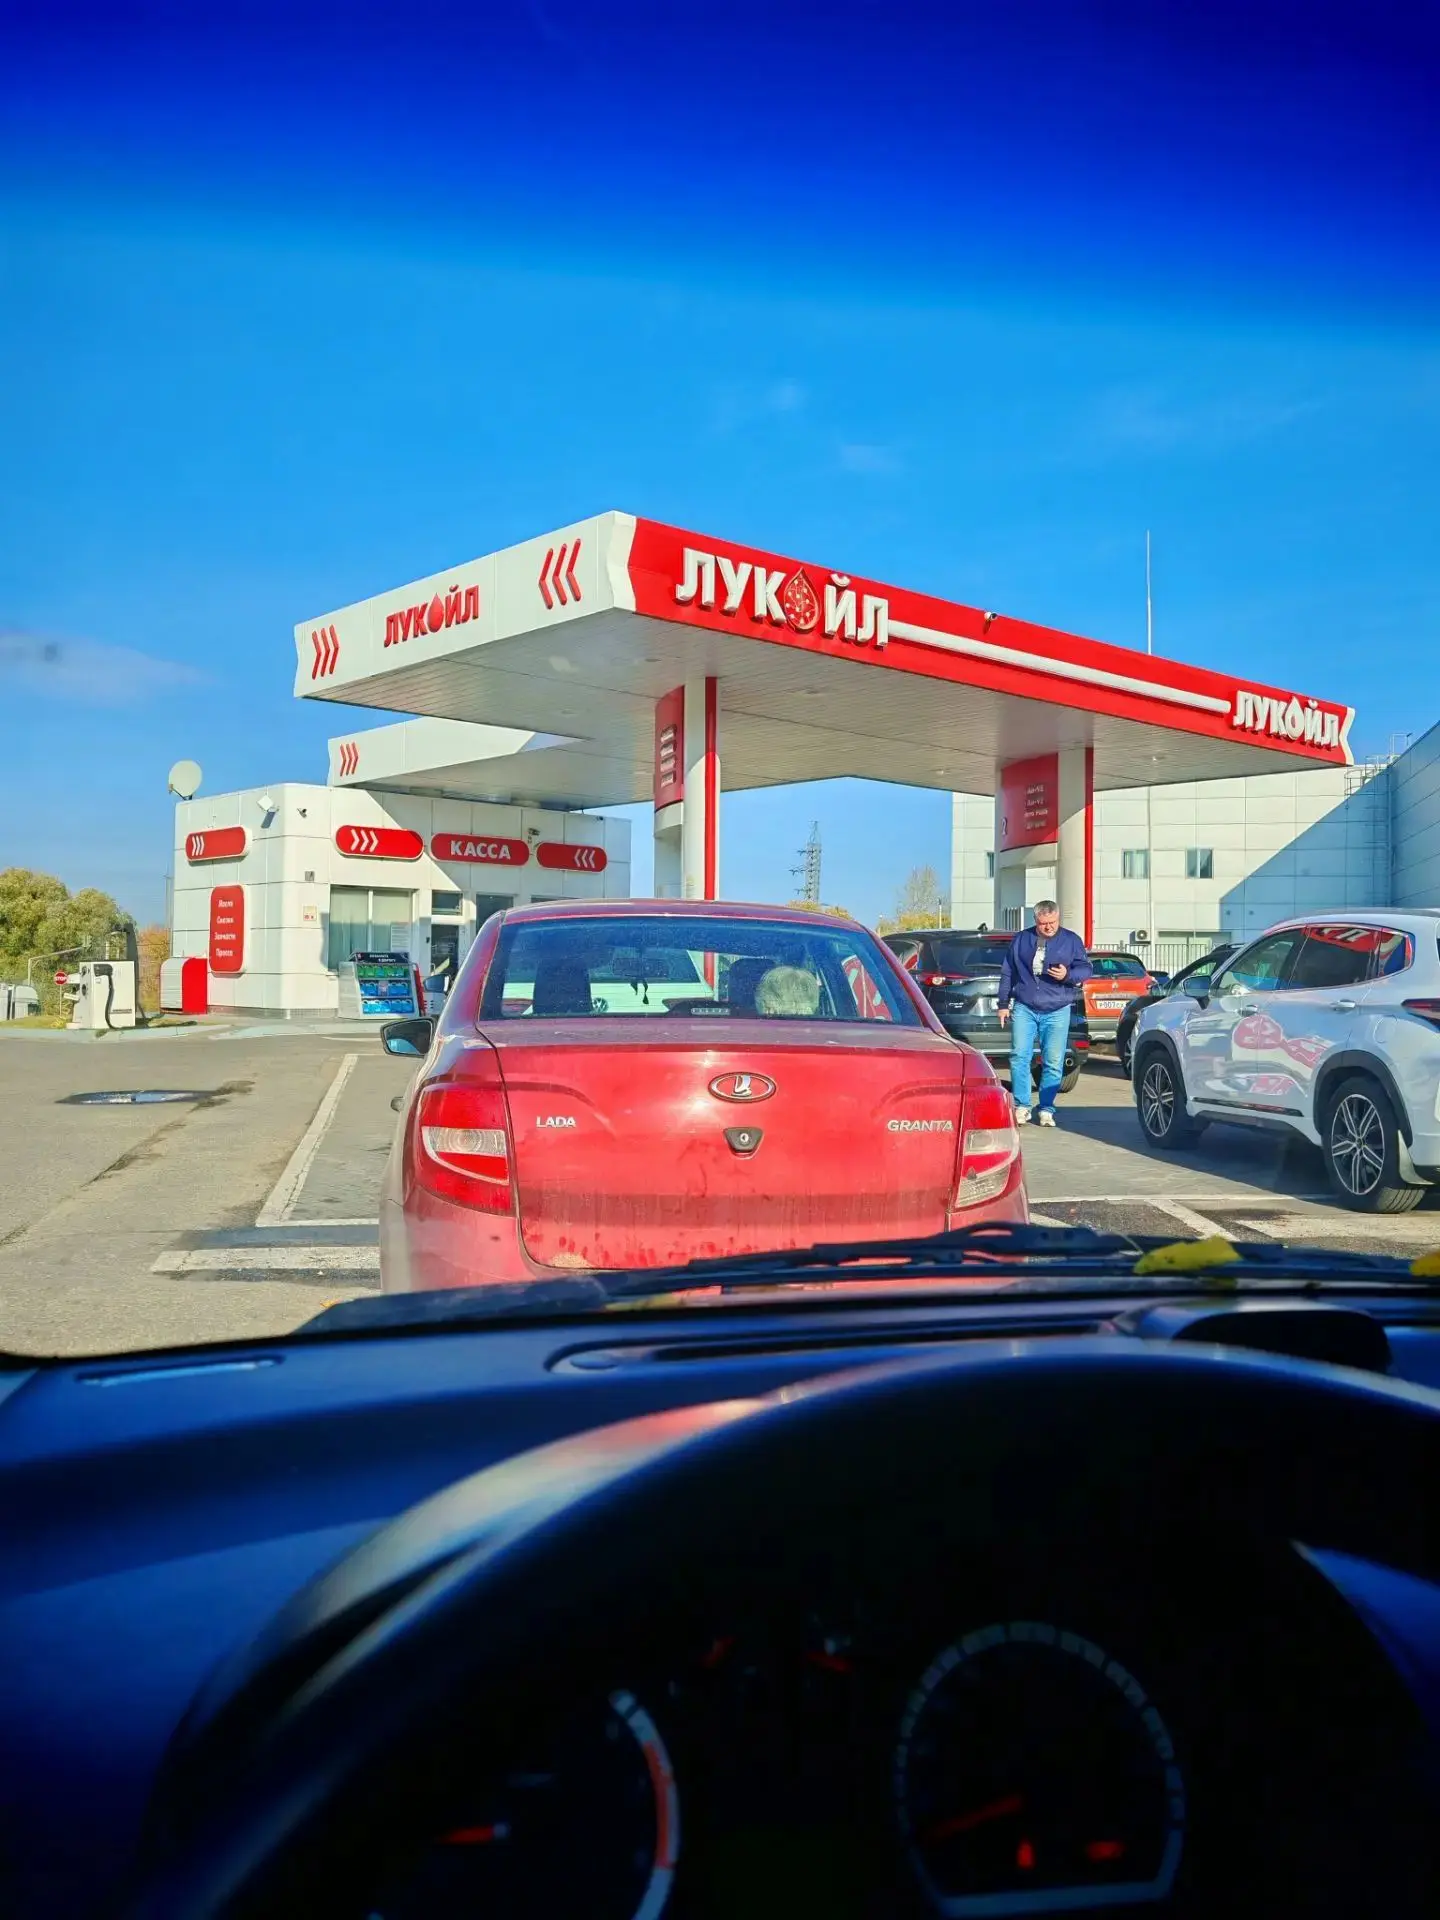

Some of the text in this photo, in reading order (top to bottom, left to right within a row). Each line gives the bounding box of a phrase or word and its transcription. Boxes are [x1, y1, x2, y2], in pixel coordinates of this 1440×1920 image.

[675, 547, 889, 646] ЛУКОЙЛ
[384, 584, 479, 648] ЛУКОЙЛ
[1233, 690, 1339, 748] ЛУКОЙЛ
[450, 841, 511, 860] КАССА
[536, 1116, 576, 1129] LADA
[887, 1119, 954, 1132] GRANTA
